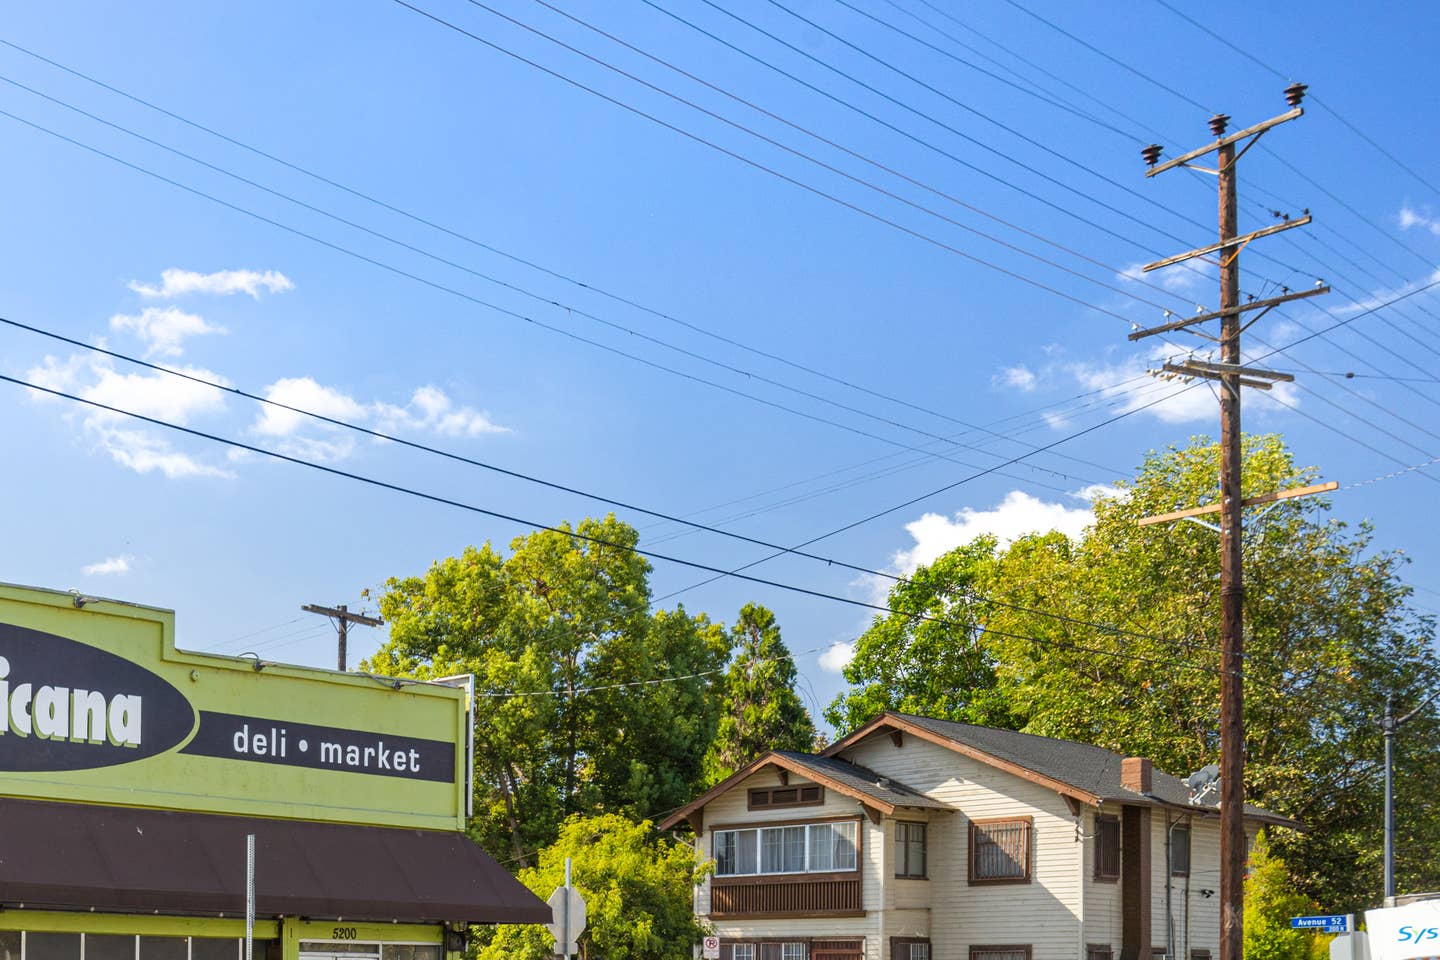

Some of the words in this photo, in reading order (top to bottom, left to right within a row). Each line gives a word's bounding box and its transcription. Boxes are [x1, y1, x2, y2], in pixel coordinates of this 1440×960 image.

[233, 724, 287, 758] deli
[320, 741, 421, 774] market
[1331, 917, 1342, 925] 52
[332, 927, 357, 940] 5200
[1397, 925, 1439, 945] Sys
